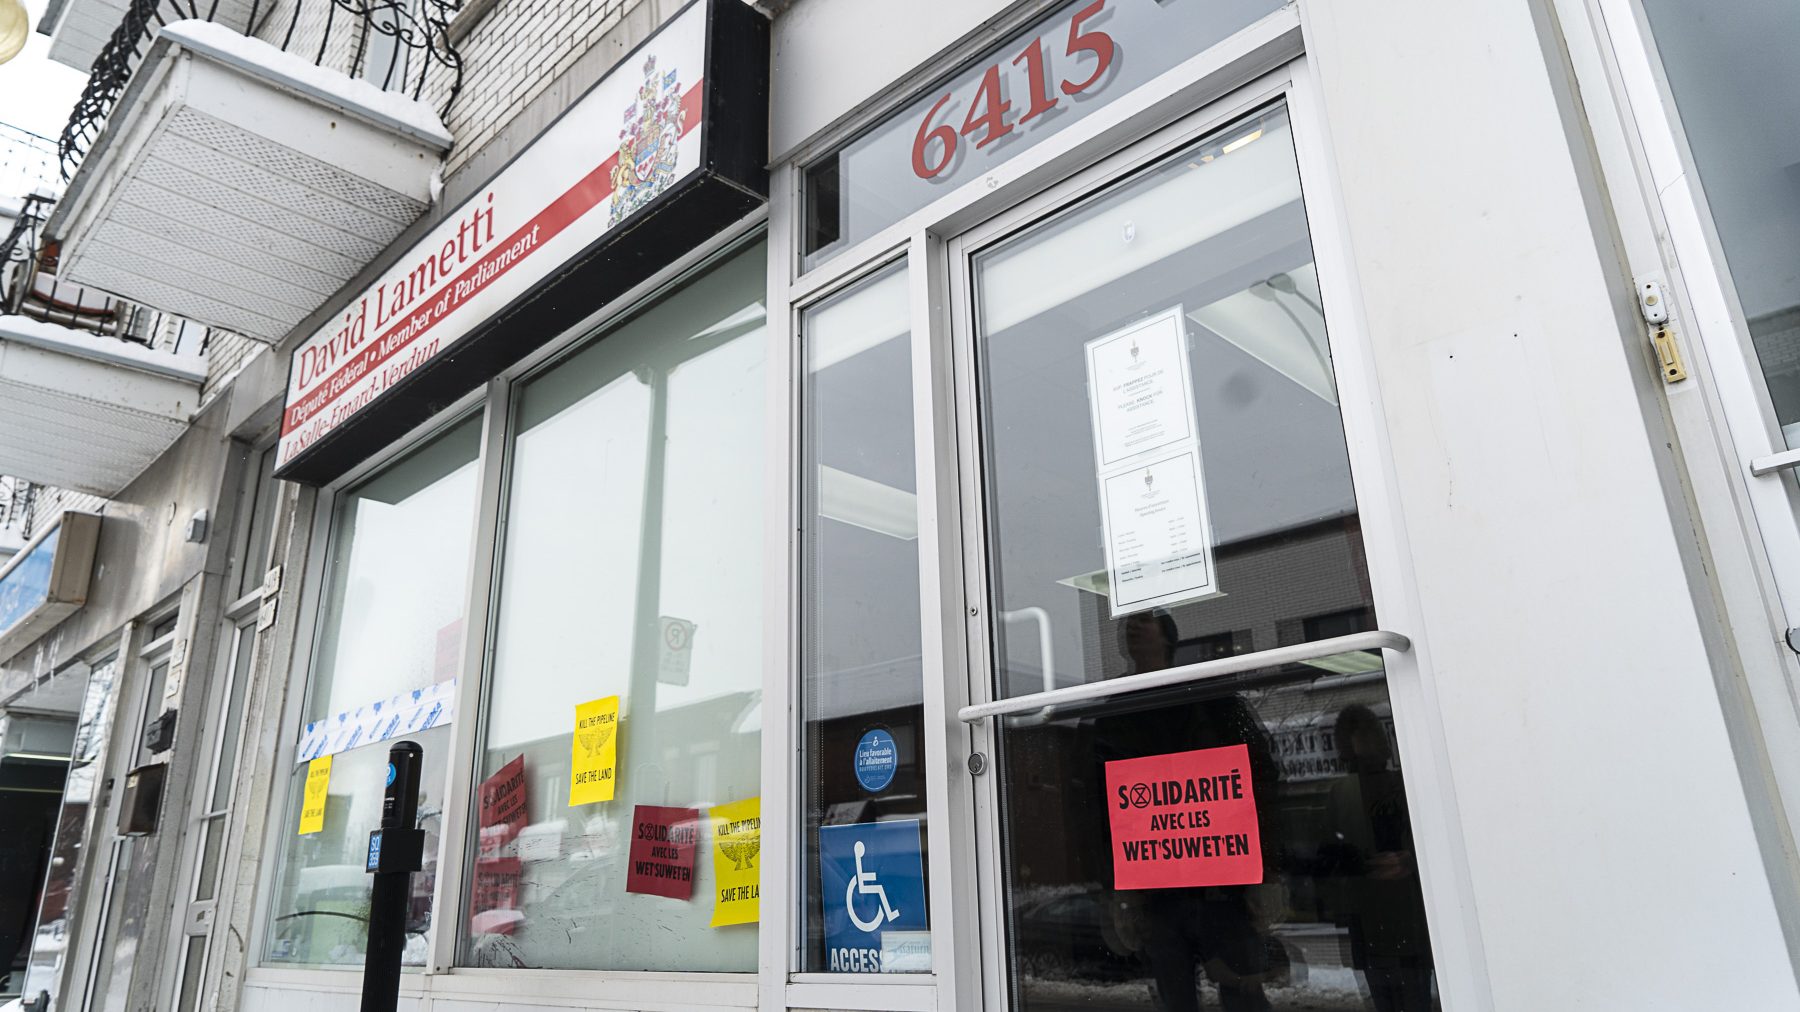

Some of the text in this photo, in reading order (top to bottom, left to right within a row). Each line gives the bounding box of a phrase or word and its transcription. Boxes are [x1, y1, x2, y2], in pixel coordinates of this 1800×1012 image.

[911, 0, 1115, 180] 6415
[299, 192, 495, 391] David Lametti
[291, 223, 540, 426] Député Fédéral Member of Parliament
[579, 711, 616, 730] KILL THE PIPELINE
[870, 747, 892, 757] favorable
[575, 767, 612, 785] SAVE THE LAND
[1118, 768, 1243, 810] SOLIDARITÉ
[717, 824, 730, 836] KILL
[730, 820, 741, 833] THE
[1150, 810, 1211, 831] AVEC LES
[638, 822, 695, 845] SOLIDARITÉ
[651, 846, 679, 860] AVEC LES
[1122, 833, 1249, 861] WET'SUWET'EN
[721, 887, 736, 903] SAVE
[737, 885, 750, 900] THE
[830, 947, 885, 973] ACCES
